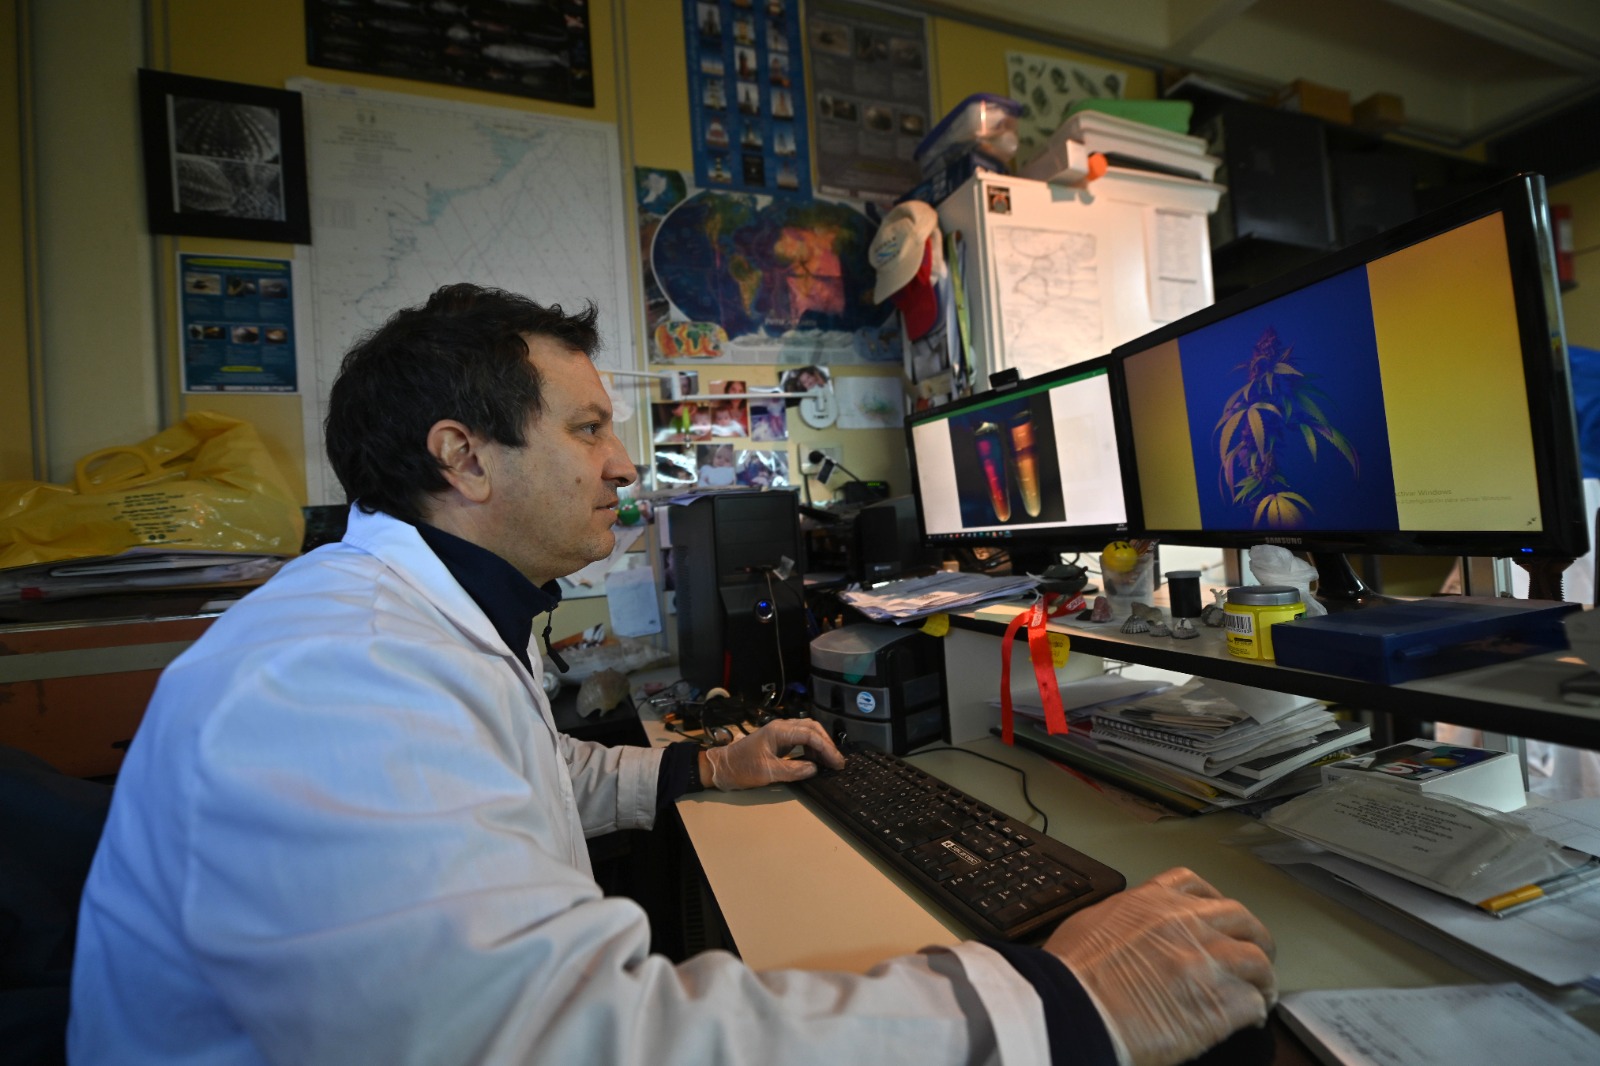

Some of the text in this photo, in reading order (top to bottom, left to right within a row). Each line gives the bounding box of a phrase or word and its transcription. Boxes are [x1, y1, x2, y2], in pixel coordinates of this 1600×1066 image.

[1418, 488, 1453, 497] Windows
[1264, 536, 1303, 545] SAMSUNG
[1424, 806, 1457, 818] VIVES
